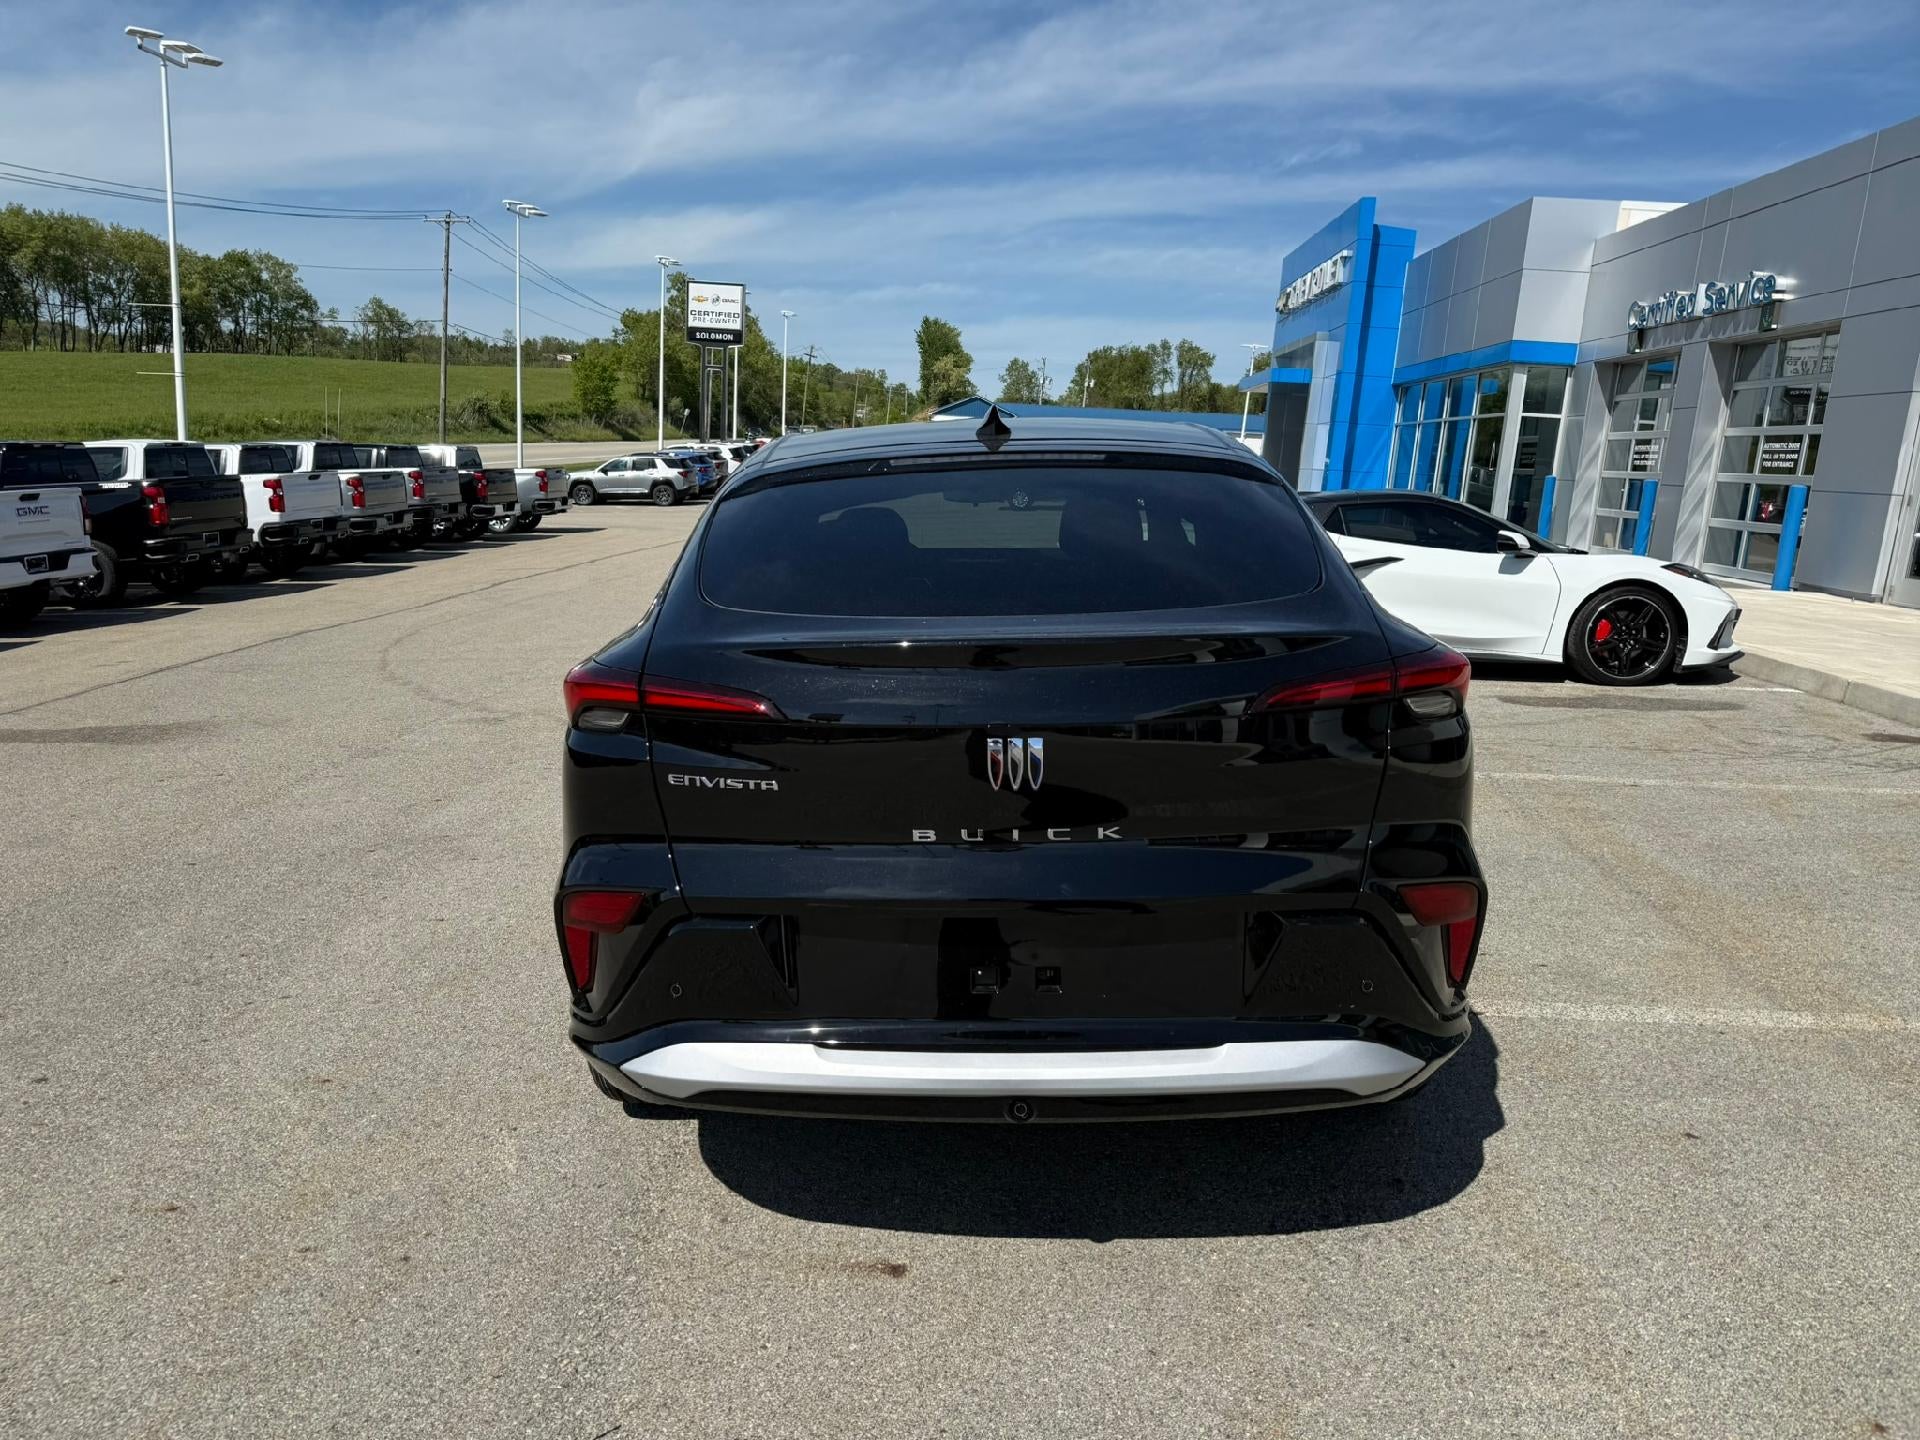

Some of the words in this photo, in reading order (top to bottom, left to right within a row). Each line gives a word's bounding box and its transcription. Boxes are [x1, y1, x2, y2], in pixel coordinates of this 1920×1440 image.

[1628, 290, 1699, 330] Certified
[1702, 271, 1777, 315] Service
[690, 309, 740, 319] CERTIFIED
[692, 316, 737, 324] PRE-OWNED
[696, 332, 733, 341] SOLOMON
[16, 505, 50, 517] GMC
[668, 773, 779, 792] ENVISTA
[912, 826, 1123, 843] BUICK
